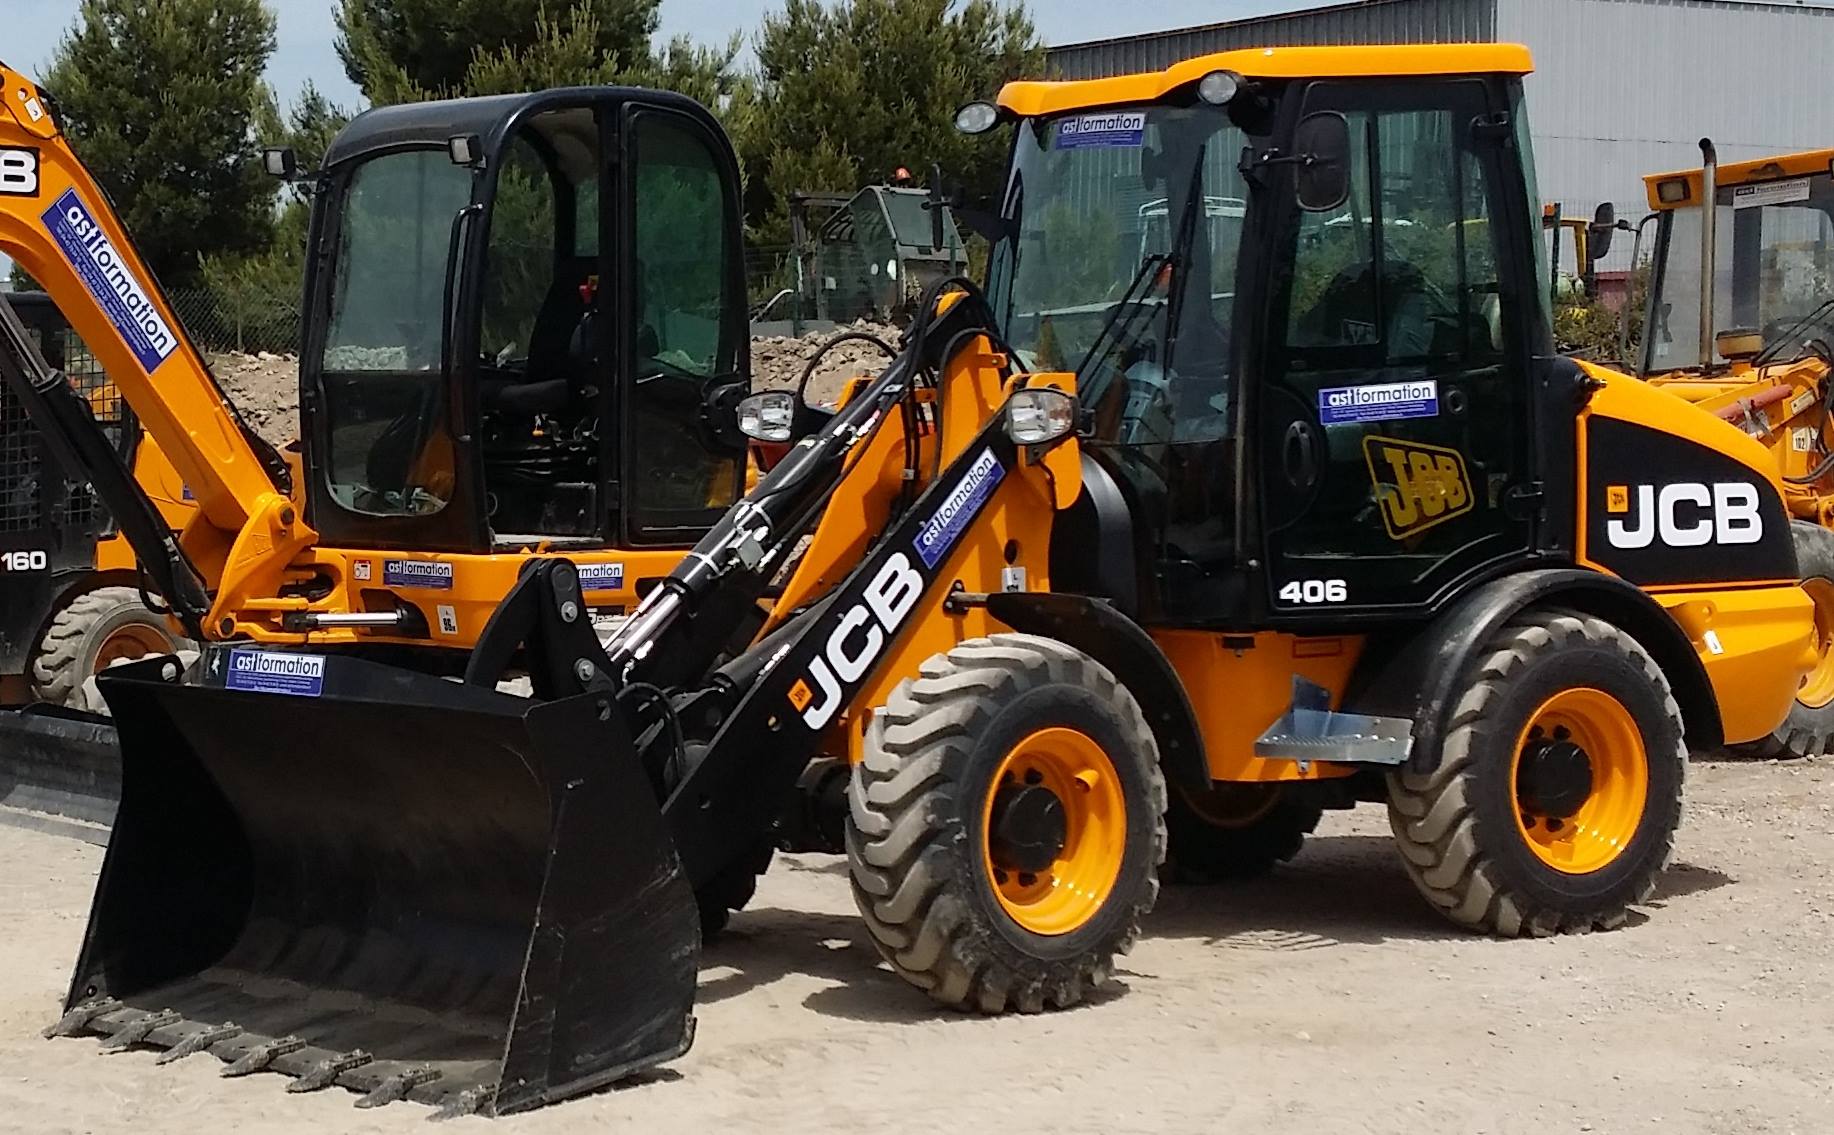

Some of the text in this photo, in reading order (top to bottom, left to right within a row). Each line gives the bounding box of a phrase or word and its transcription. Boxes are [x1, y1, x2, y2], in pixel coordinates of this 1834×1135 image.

[1382, 447, 1467, 527] JCB
[1607, 482, 1763, 549] JCB
[0, 550, 47, 571] 160
[577, 563, 620, 577] rmation
[1279, 579, 1347, 603] 406
[802, 552, 924, 730] JCB
